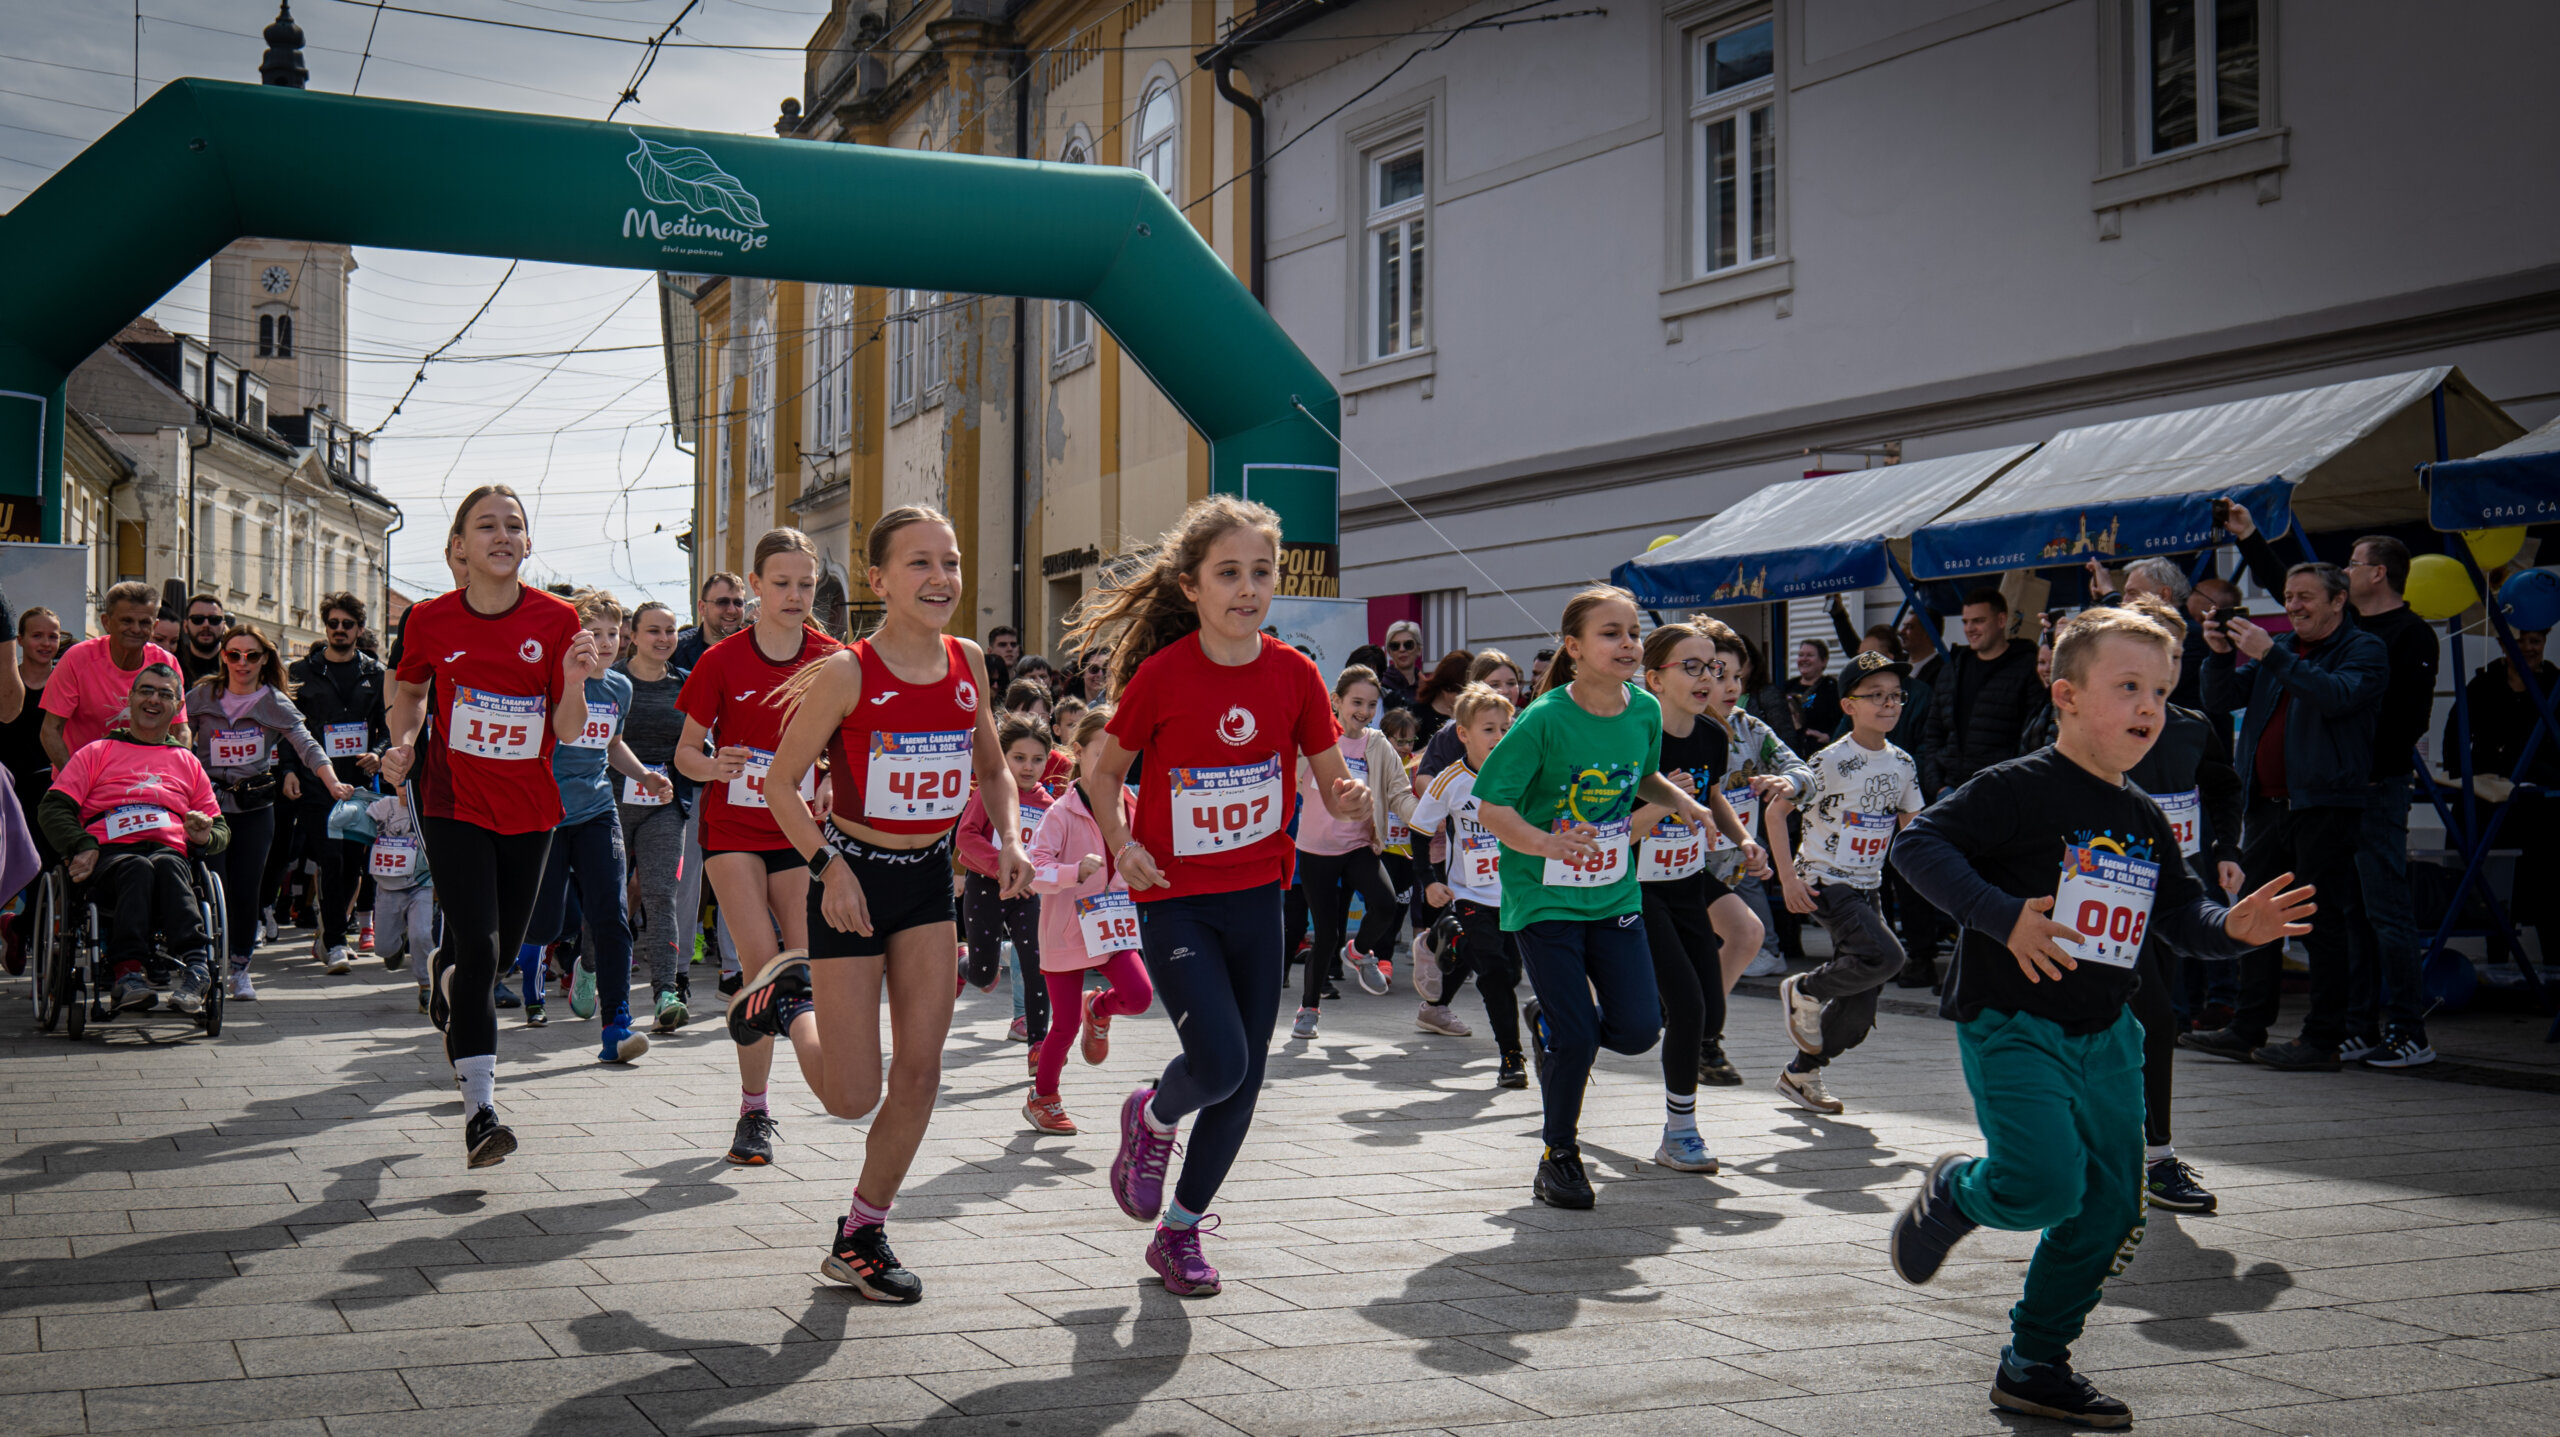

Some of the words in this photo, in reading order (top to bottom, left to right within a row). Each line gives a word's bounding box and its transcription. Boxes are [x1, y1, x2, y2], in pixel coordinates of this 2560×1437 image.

[622, 207, 768, 252] Međimurje
[2482, 504, 2526, 519] GRAD
[2145, 535, 2178, 548] GRAD
[1279, 548, 1326, 576] POLU
[1944, 556, 1971, 570] GRAD
[1977, 552, 2026, 566] ČAKOVEC
[1273, 574, 1339, 598] ARATON
[1784, 582, 1806, 593] GRAD
[1810, 576, 1855, 590] ČAKOVEC
[467, 719, 528, 746] 175
[219, 743, 257, 758] 549
[334, 736, 363, 750] 551
[905, 745, 916, 754] DO
[888, 768, 962, 800] 420
[1203, 780, 1215, 788] DO
[118, 813, 159, 830] 216
[1192, 795, 1270, 834] 407
[375, 853, 407, 868] 552
[1654, 841, 1699, 868] 455
[1096, 917, 1138, 941] 162
[2075, 899, 2147, 946] 008
